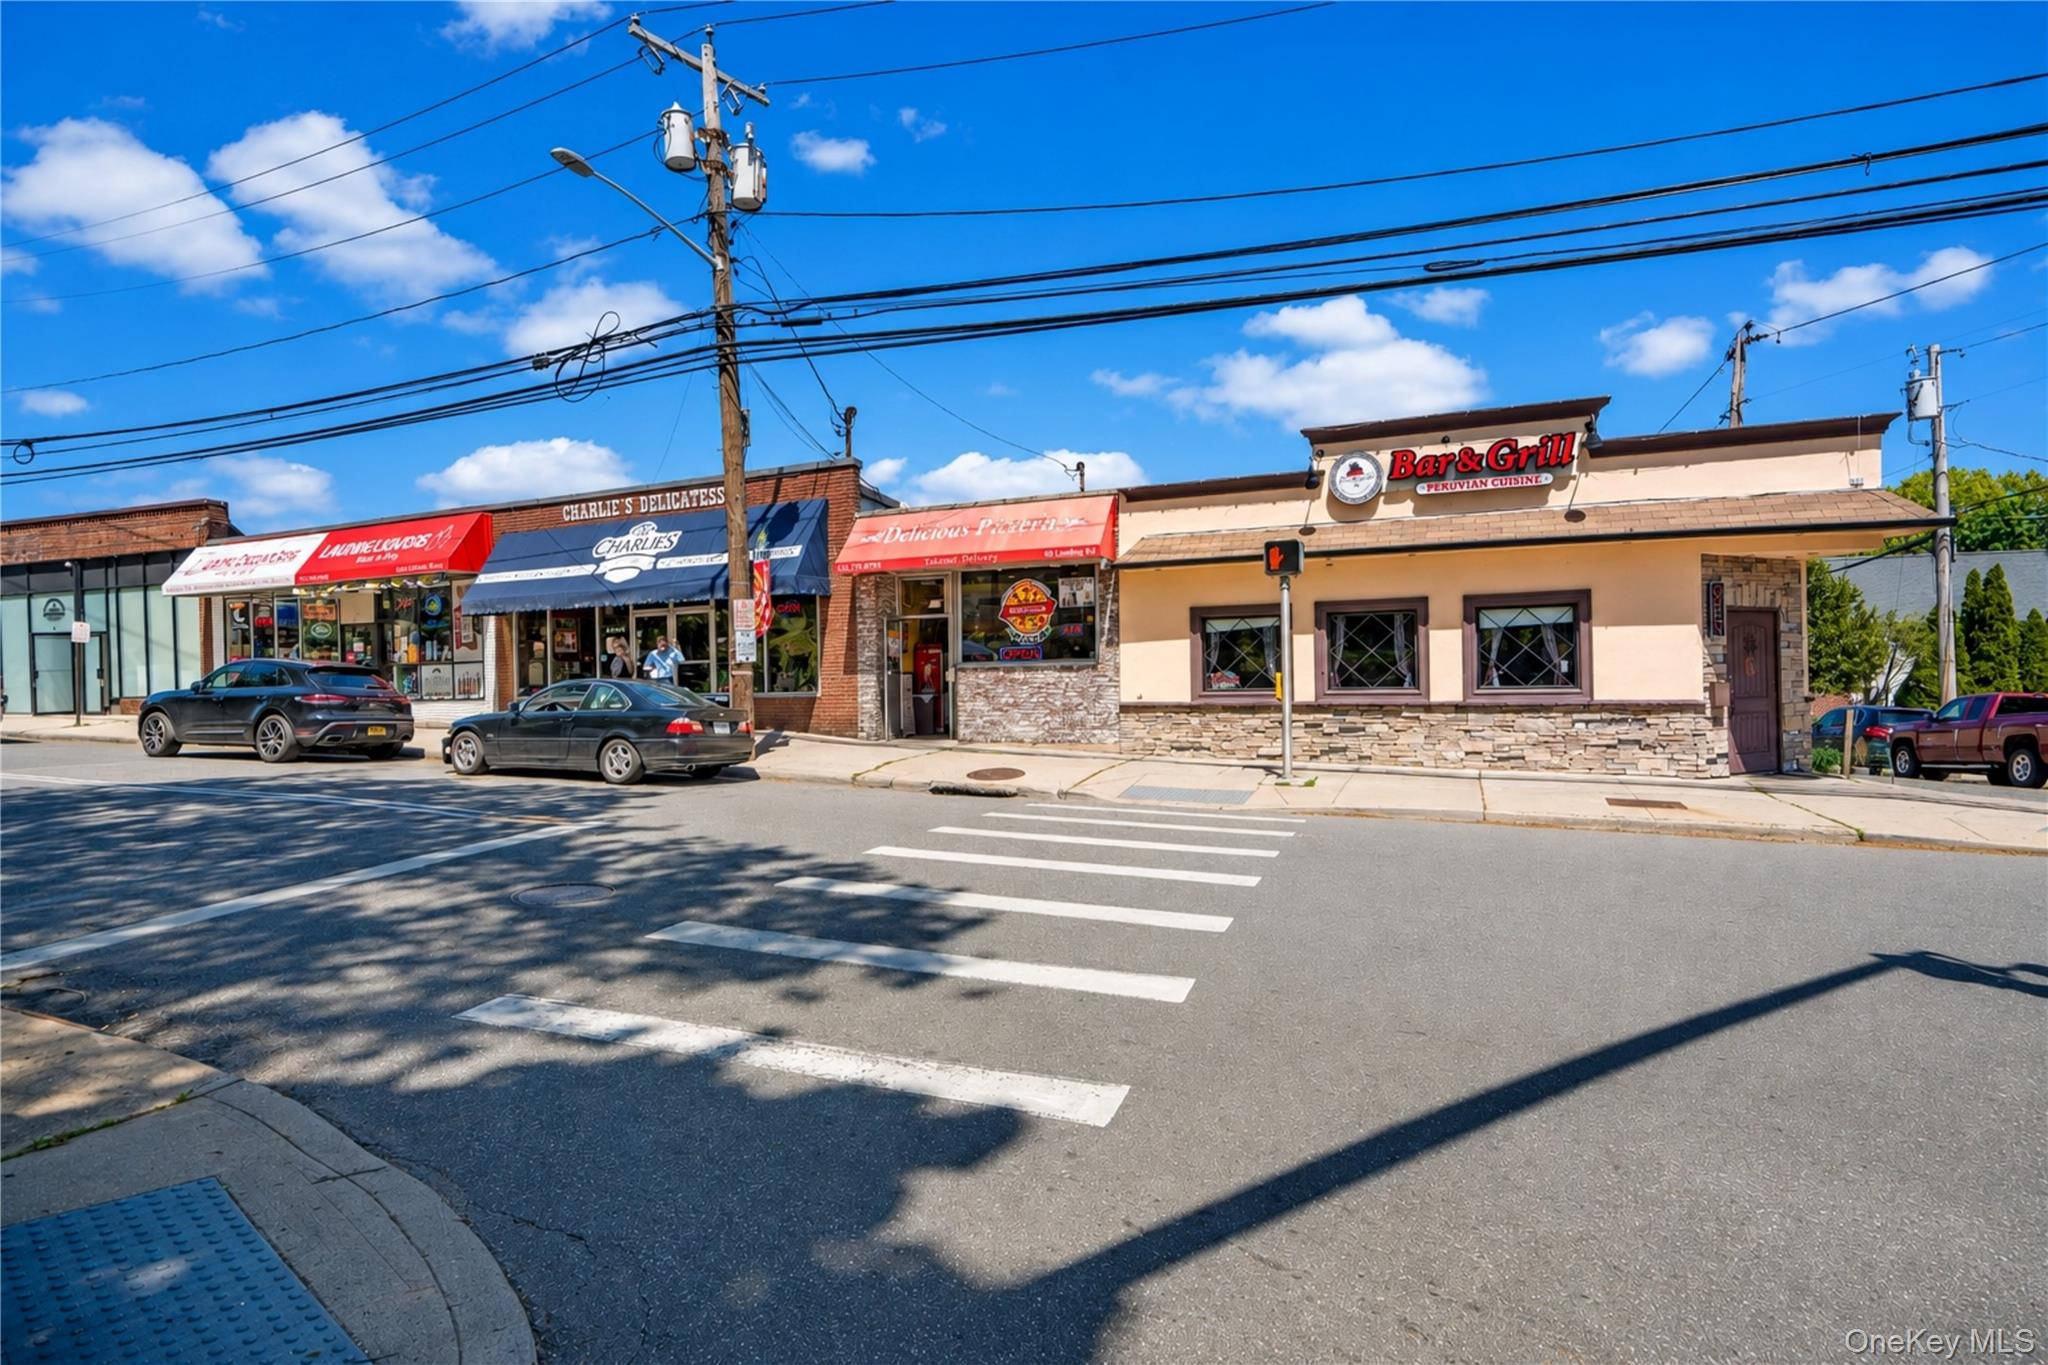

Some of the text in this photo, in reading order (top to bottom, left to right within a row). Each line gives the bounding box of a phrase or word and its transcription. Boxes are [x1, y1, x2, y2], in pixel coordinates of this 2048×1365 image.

[1426, 475, 1542, 493] PERUVIAN CUISINE
[562, 486, 725, 521] CHARLIE'S DELICATESS
[882, 515, 1059, 544] Delicious Pizzeria
